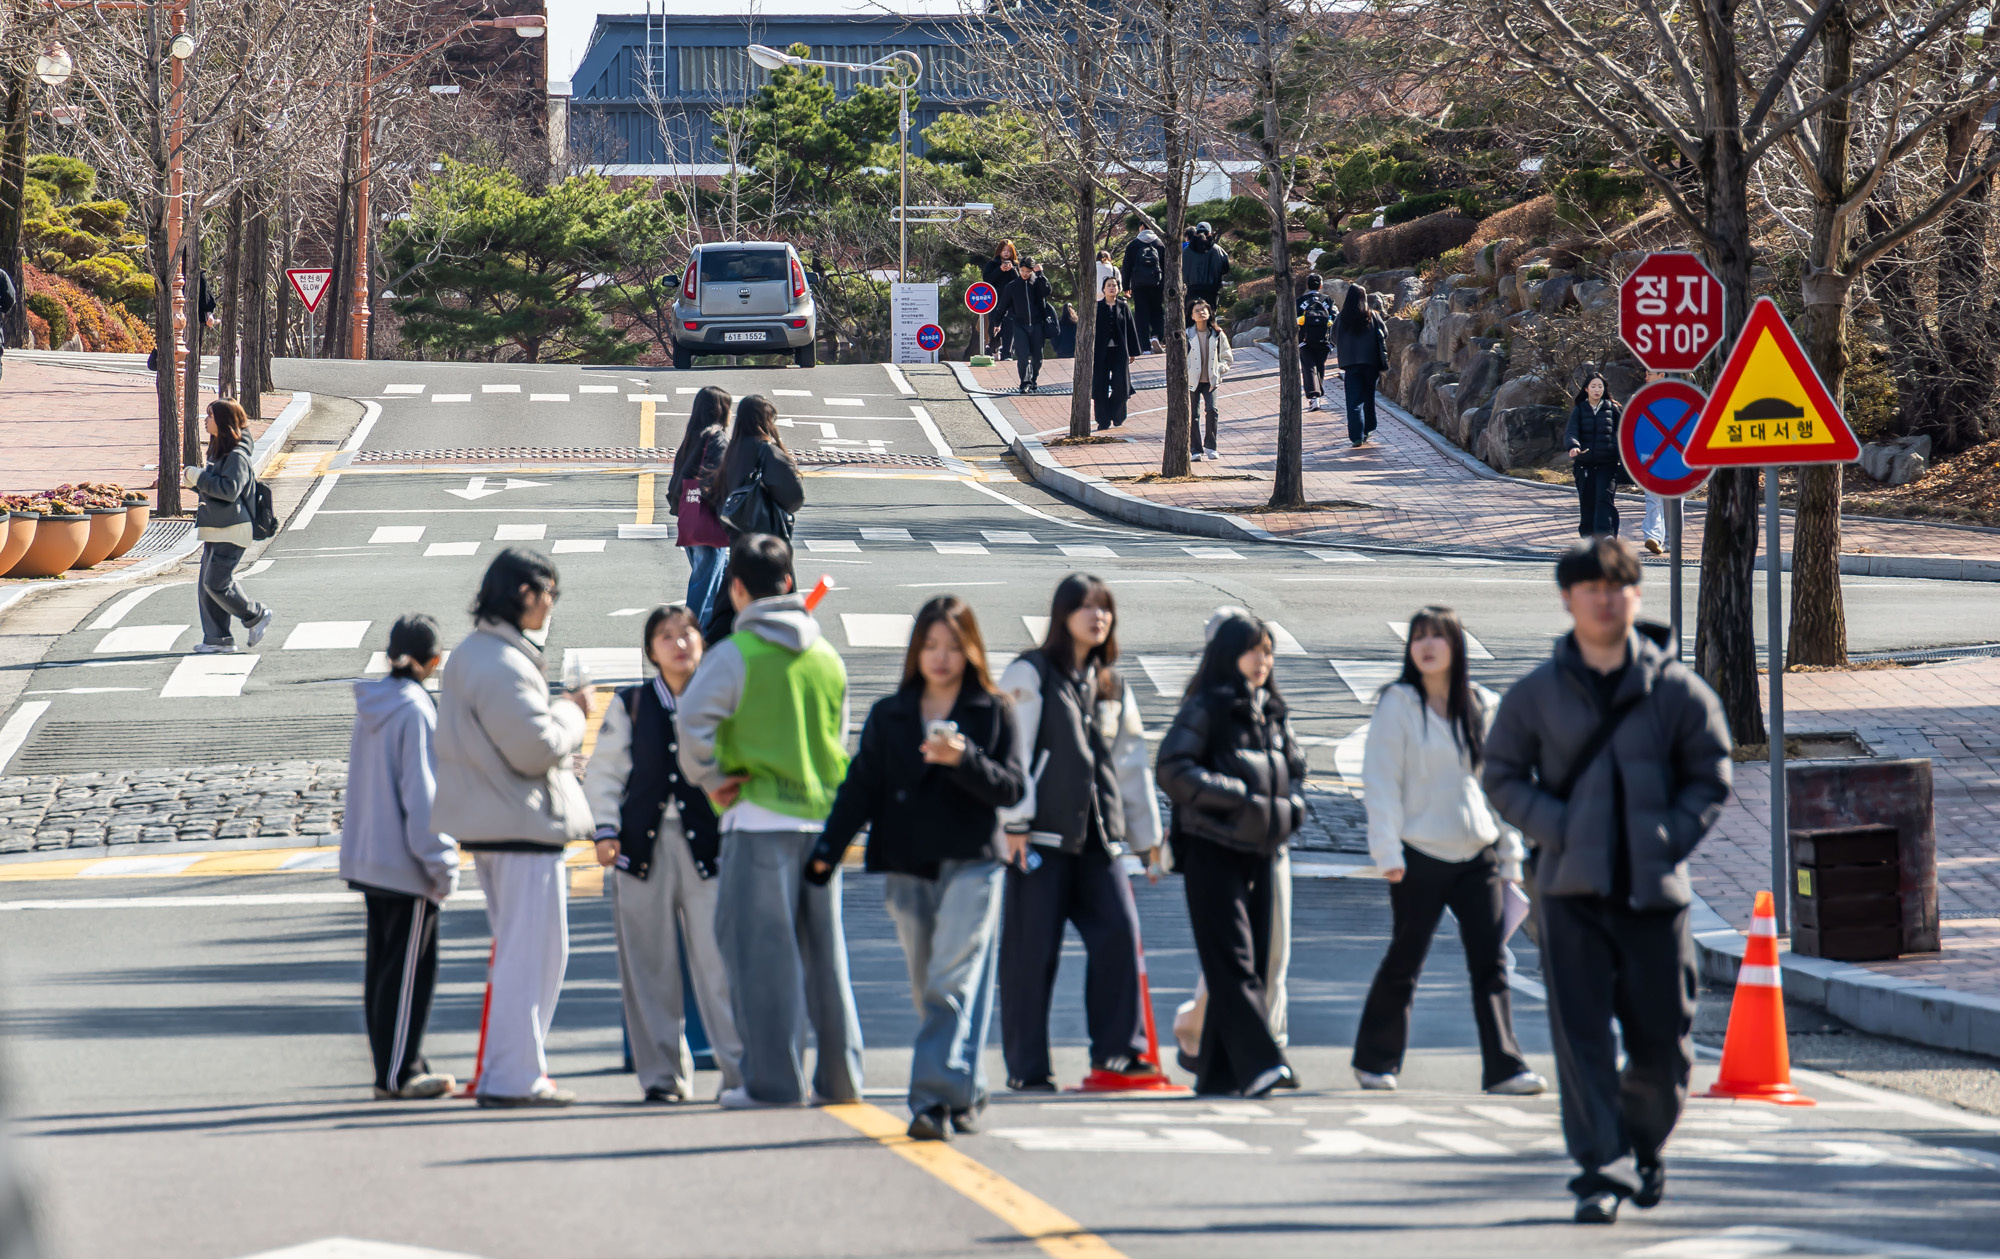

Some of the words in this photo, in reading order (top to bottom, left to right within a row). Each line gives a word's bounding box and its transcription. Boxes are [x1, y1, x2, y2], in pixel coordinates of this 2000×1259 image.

[299, 274, 323, 283] 천천히
[1634, 275, 1709, 316] 정지
[744, 332, 763, 340] 1552
[1635, 323, 1709, 354] STOP
[1727, 420, 1813, 443] 절대서행
